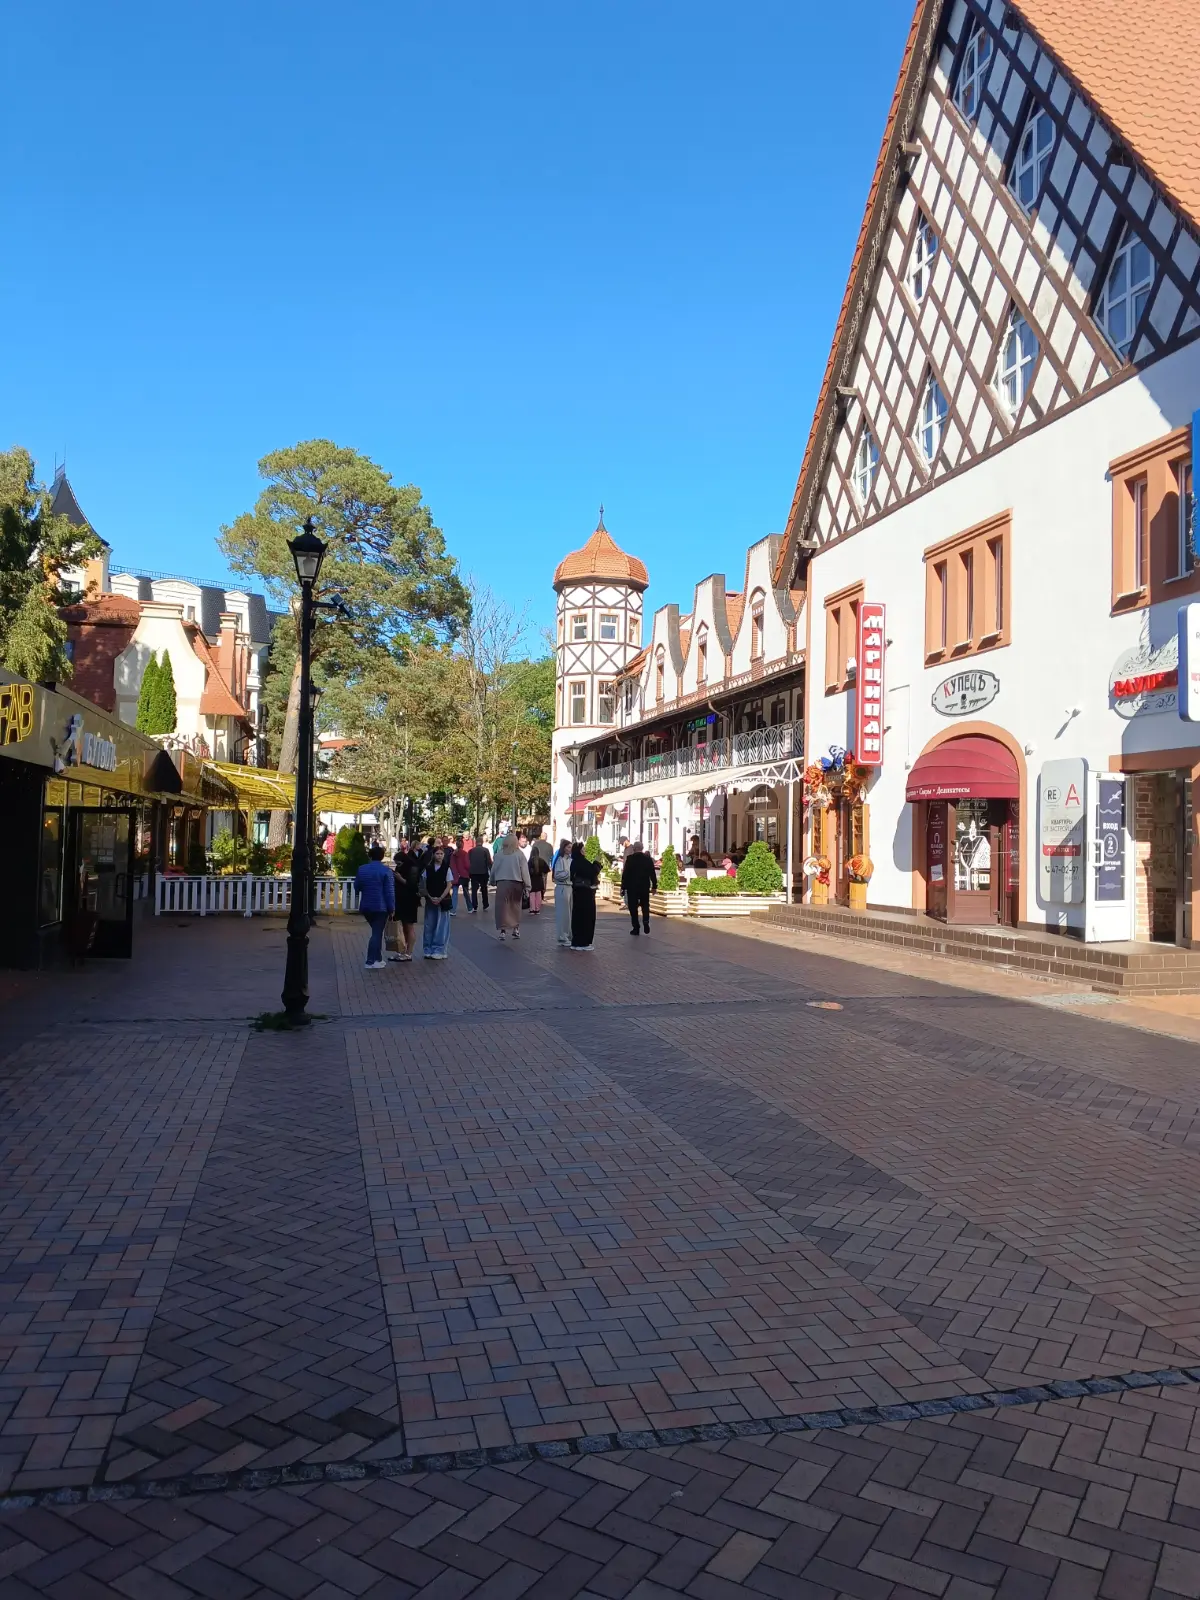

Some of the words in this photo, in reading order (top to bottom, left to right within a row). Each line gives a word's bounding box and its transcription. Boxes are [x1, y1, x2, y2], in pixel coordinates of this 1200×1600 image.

[863, 615, 884, 753] МАРЦИПАН
[943, 673, 986, 698] КУПЕЦЪ
[1047, 789, 1057, 800] RE
[1102, 822, 1119, 831] ВХОД
[1107, 840, 1114, 850] 2
